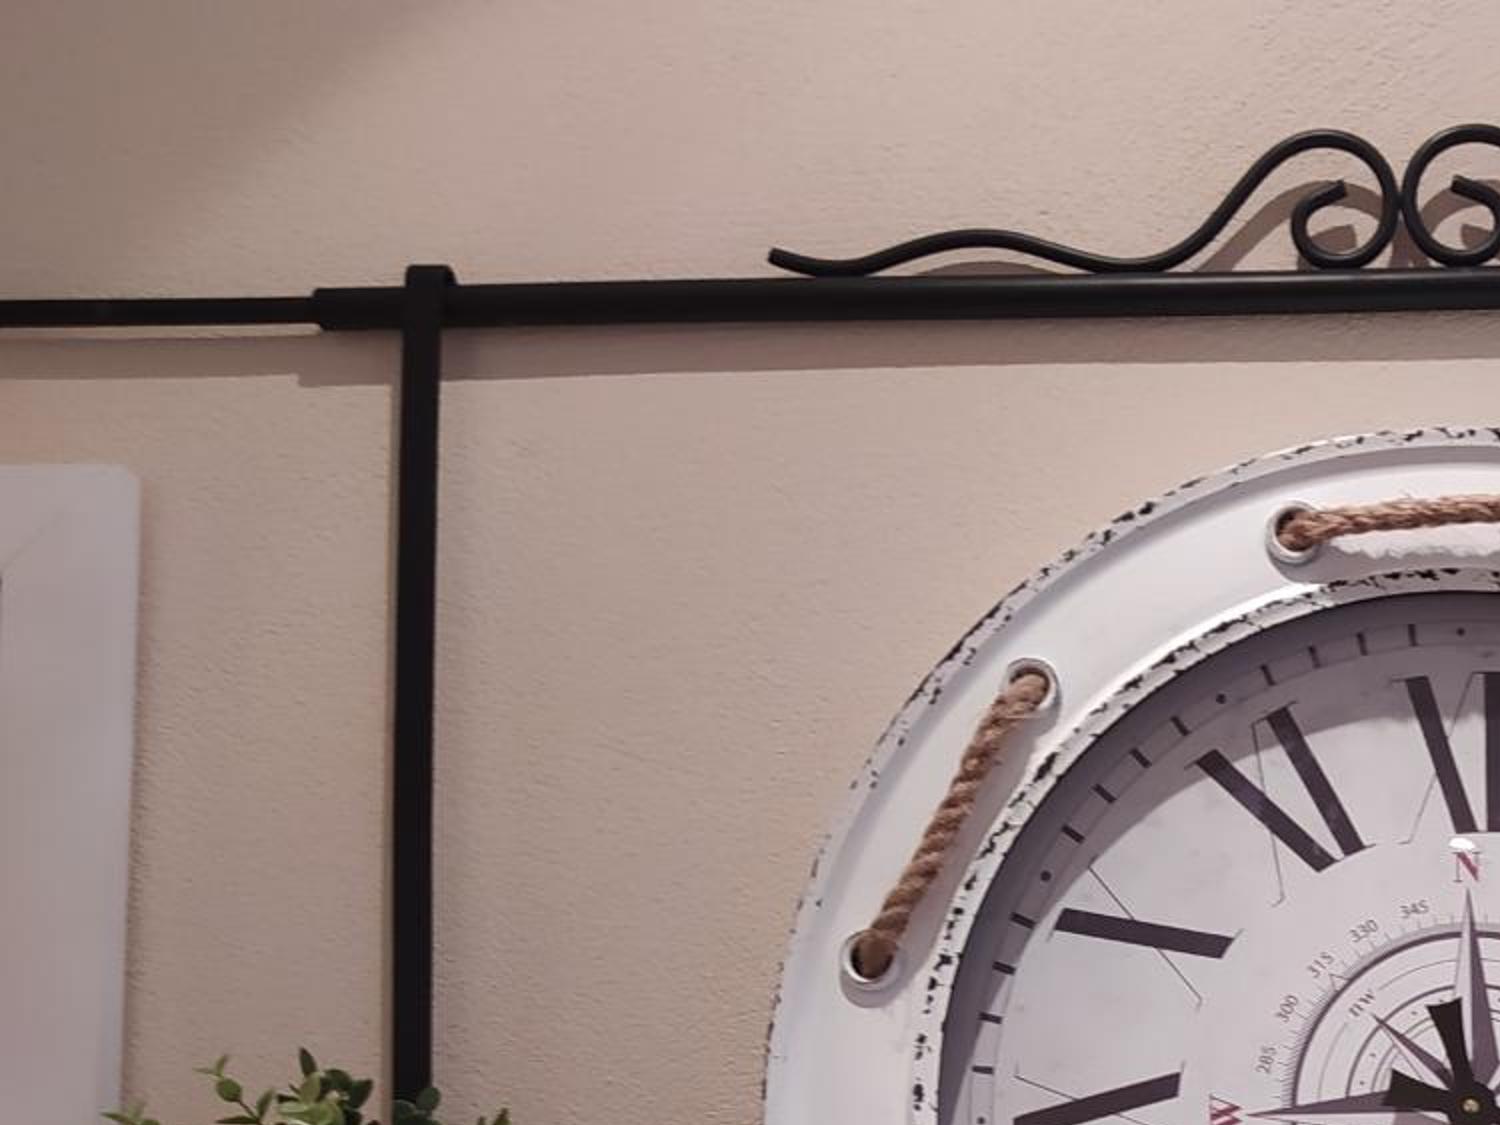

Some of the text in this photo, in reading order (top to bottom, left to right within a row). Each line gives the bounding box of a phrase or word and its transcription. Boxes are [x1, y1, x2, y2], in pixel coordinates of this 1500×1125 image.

[1183, 701, 1377, 906] XI
[1451, 850, 1482, 883] N
[1400, 900, 1429, 919] 345
[1045, 856, 1245, 1014] X
[1349, 918, 1379, 944] 330
[1306, 951, 1336, 979] 315
[1273, 994, 1300, 1024] 300
[1255, 1045, 1278, 1075] 285
